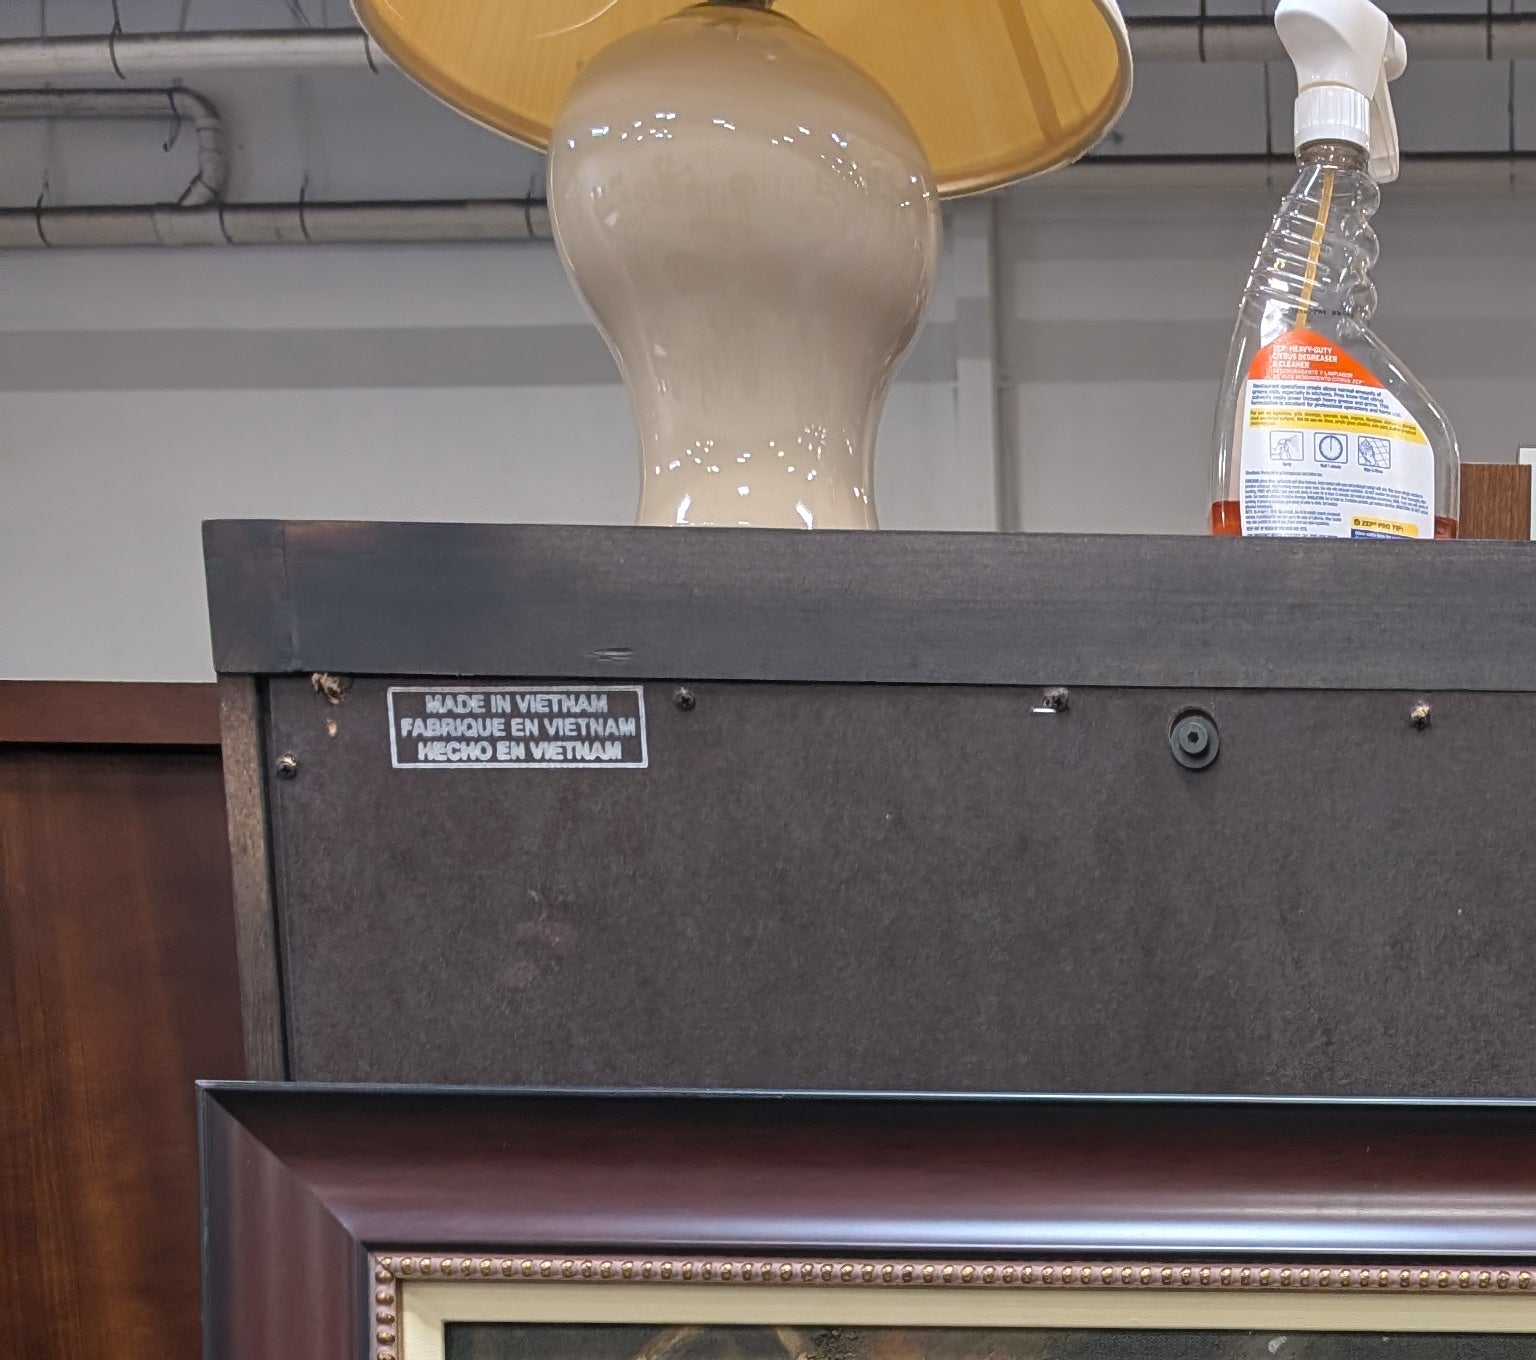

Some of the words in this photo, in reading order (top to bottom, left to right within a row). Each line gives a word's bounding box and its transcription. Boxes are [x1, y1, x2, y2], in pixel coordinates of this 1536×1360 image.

[1289, 346, 1332, 355] HEAVY-DUTY
[1298, 354, 1338, 363] DEGREASER
[1378, 522, 1391, 530] PRO
[425, 694, 486, 714] MADE
[490, 694, 511, 714] IN
[515, 694, 608, 714] VIETNAM
[400, 718, 506, 738] FABRIQUE
[511, 718, 540, 737] EN
[543, 718, 636, 737] VIETNAM
[418, 741, 492, 761] HECHO
[496, 741, 525, 760] EN
[530, 741, 622, 761] VIETNAM
